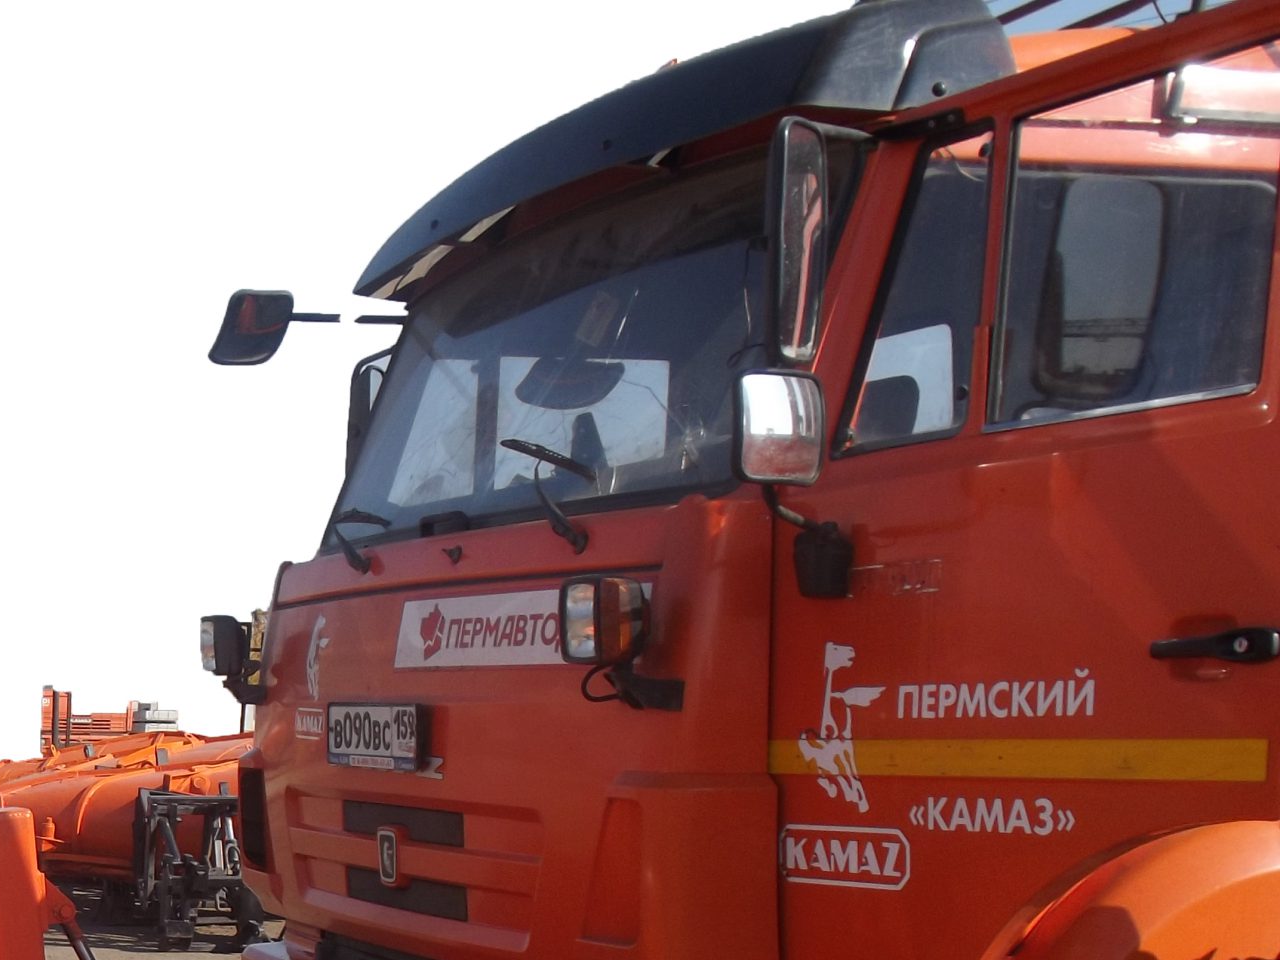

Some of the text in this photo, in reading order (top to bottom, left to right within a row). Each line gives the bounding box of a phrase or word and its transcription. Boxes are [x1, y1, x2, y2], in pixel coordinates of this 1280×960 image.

[445, 612, 560, 653] ПЕРМАВТО
[897, 668, 1096, 719] ПЕРМСКИЙ
[909, 797, 1076, 836] «КАМАЗ»
[785, 837, 902, 877] KAMAZ
